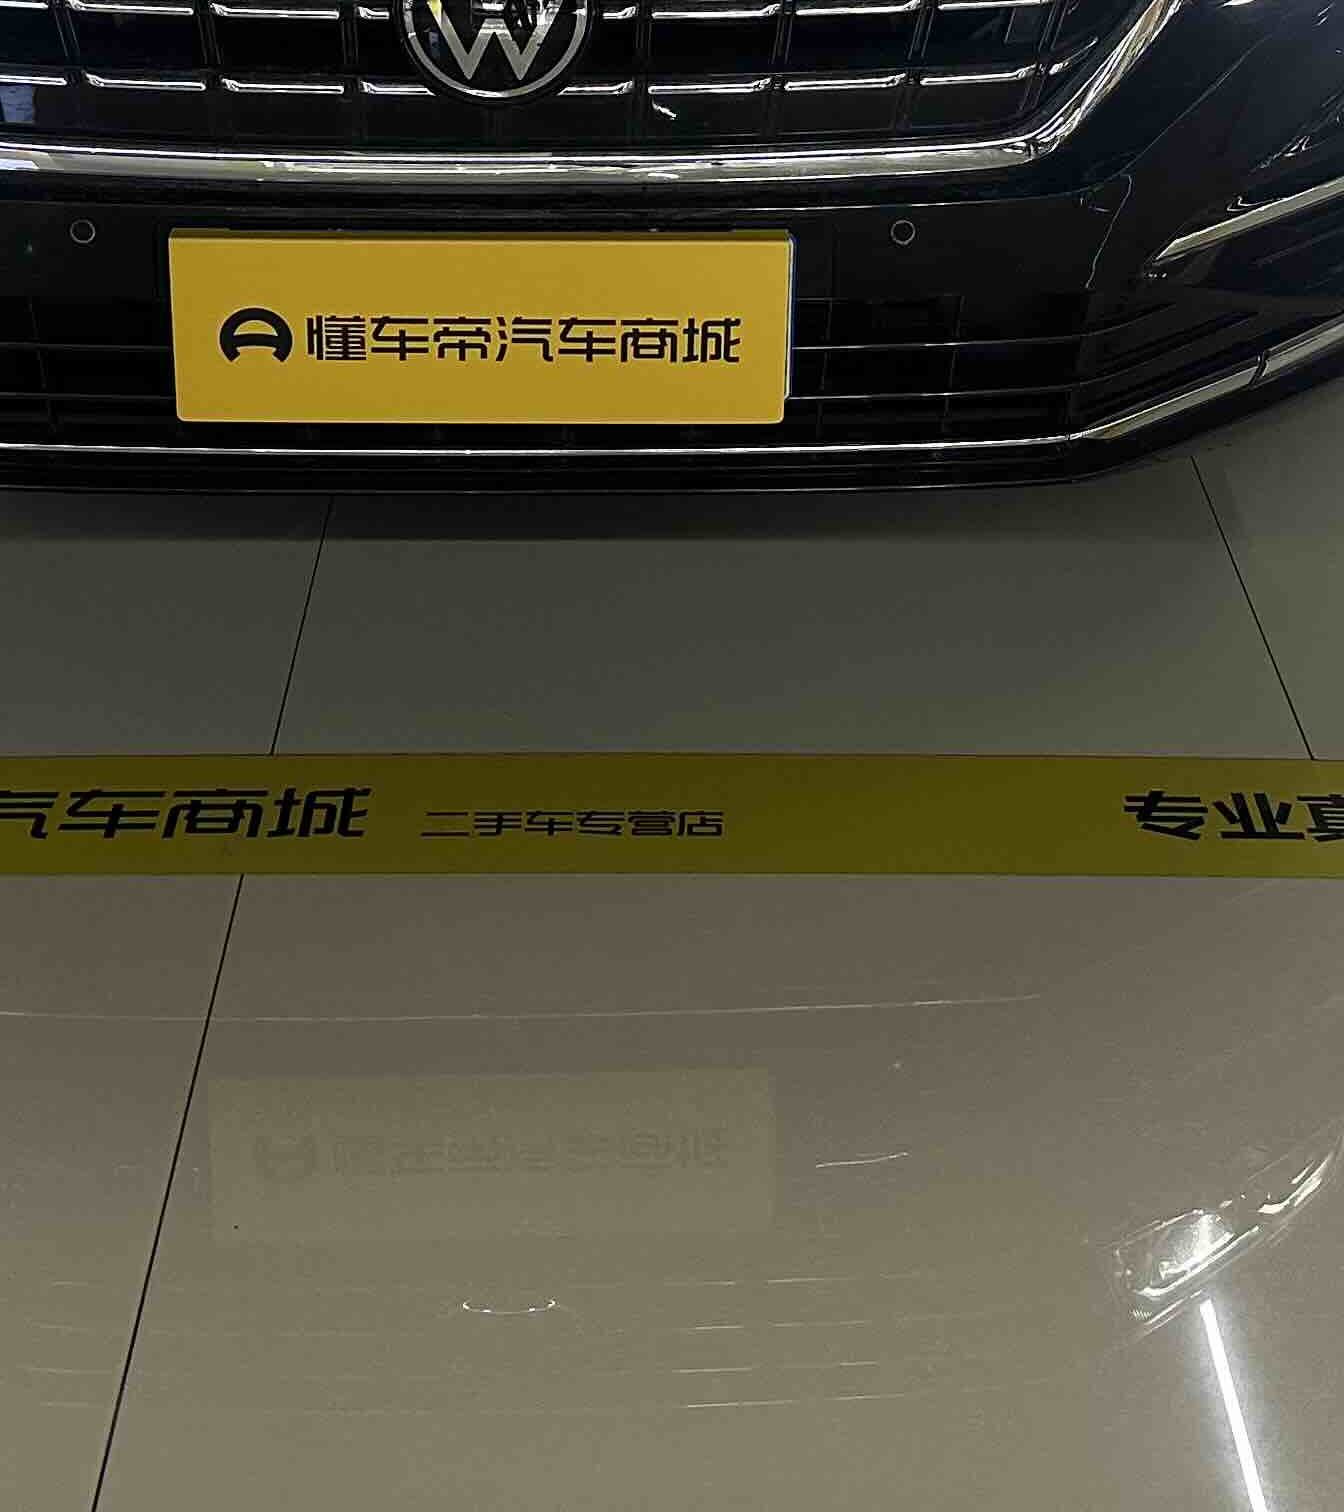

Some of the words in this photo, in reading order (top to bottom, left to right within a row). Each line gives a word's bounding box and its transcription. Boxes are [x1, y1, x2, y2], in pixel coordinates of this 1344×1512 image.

[306, 315, 741, 364] 懂车帝汽车商城
[420, 810, 724, 837] 二手车专营店
